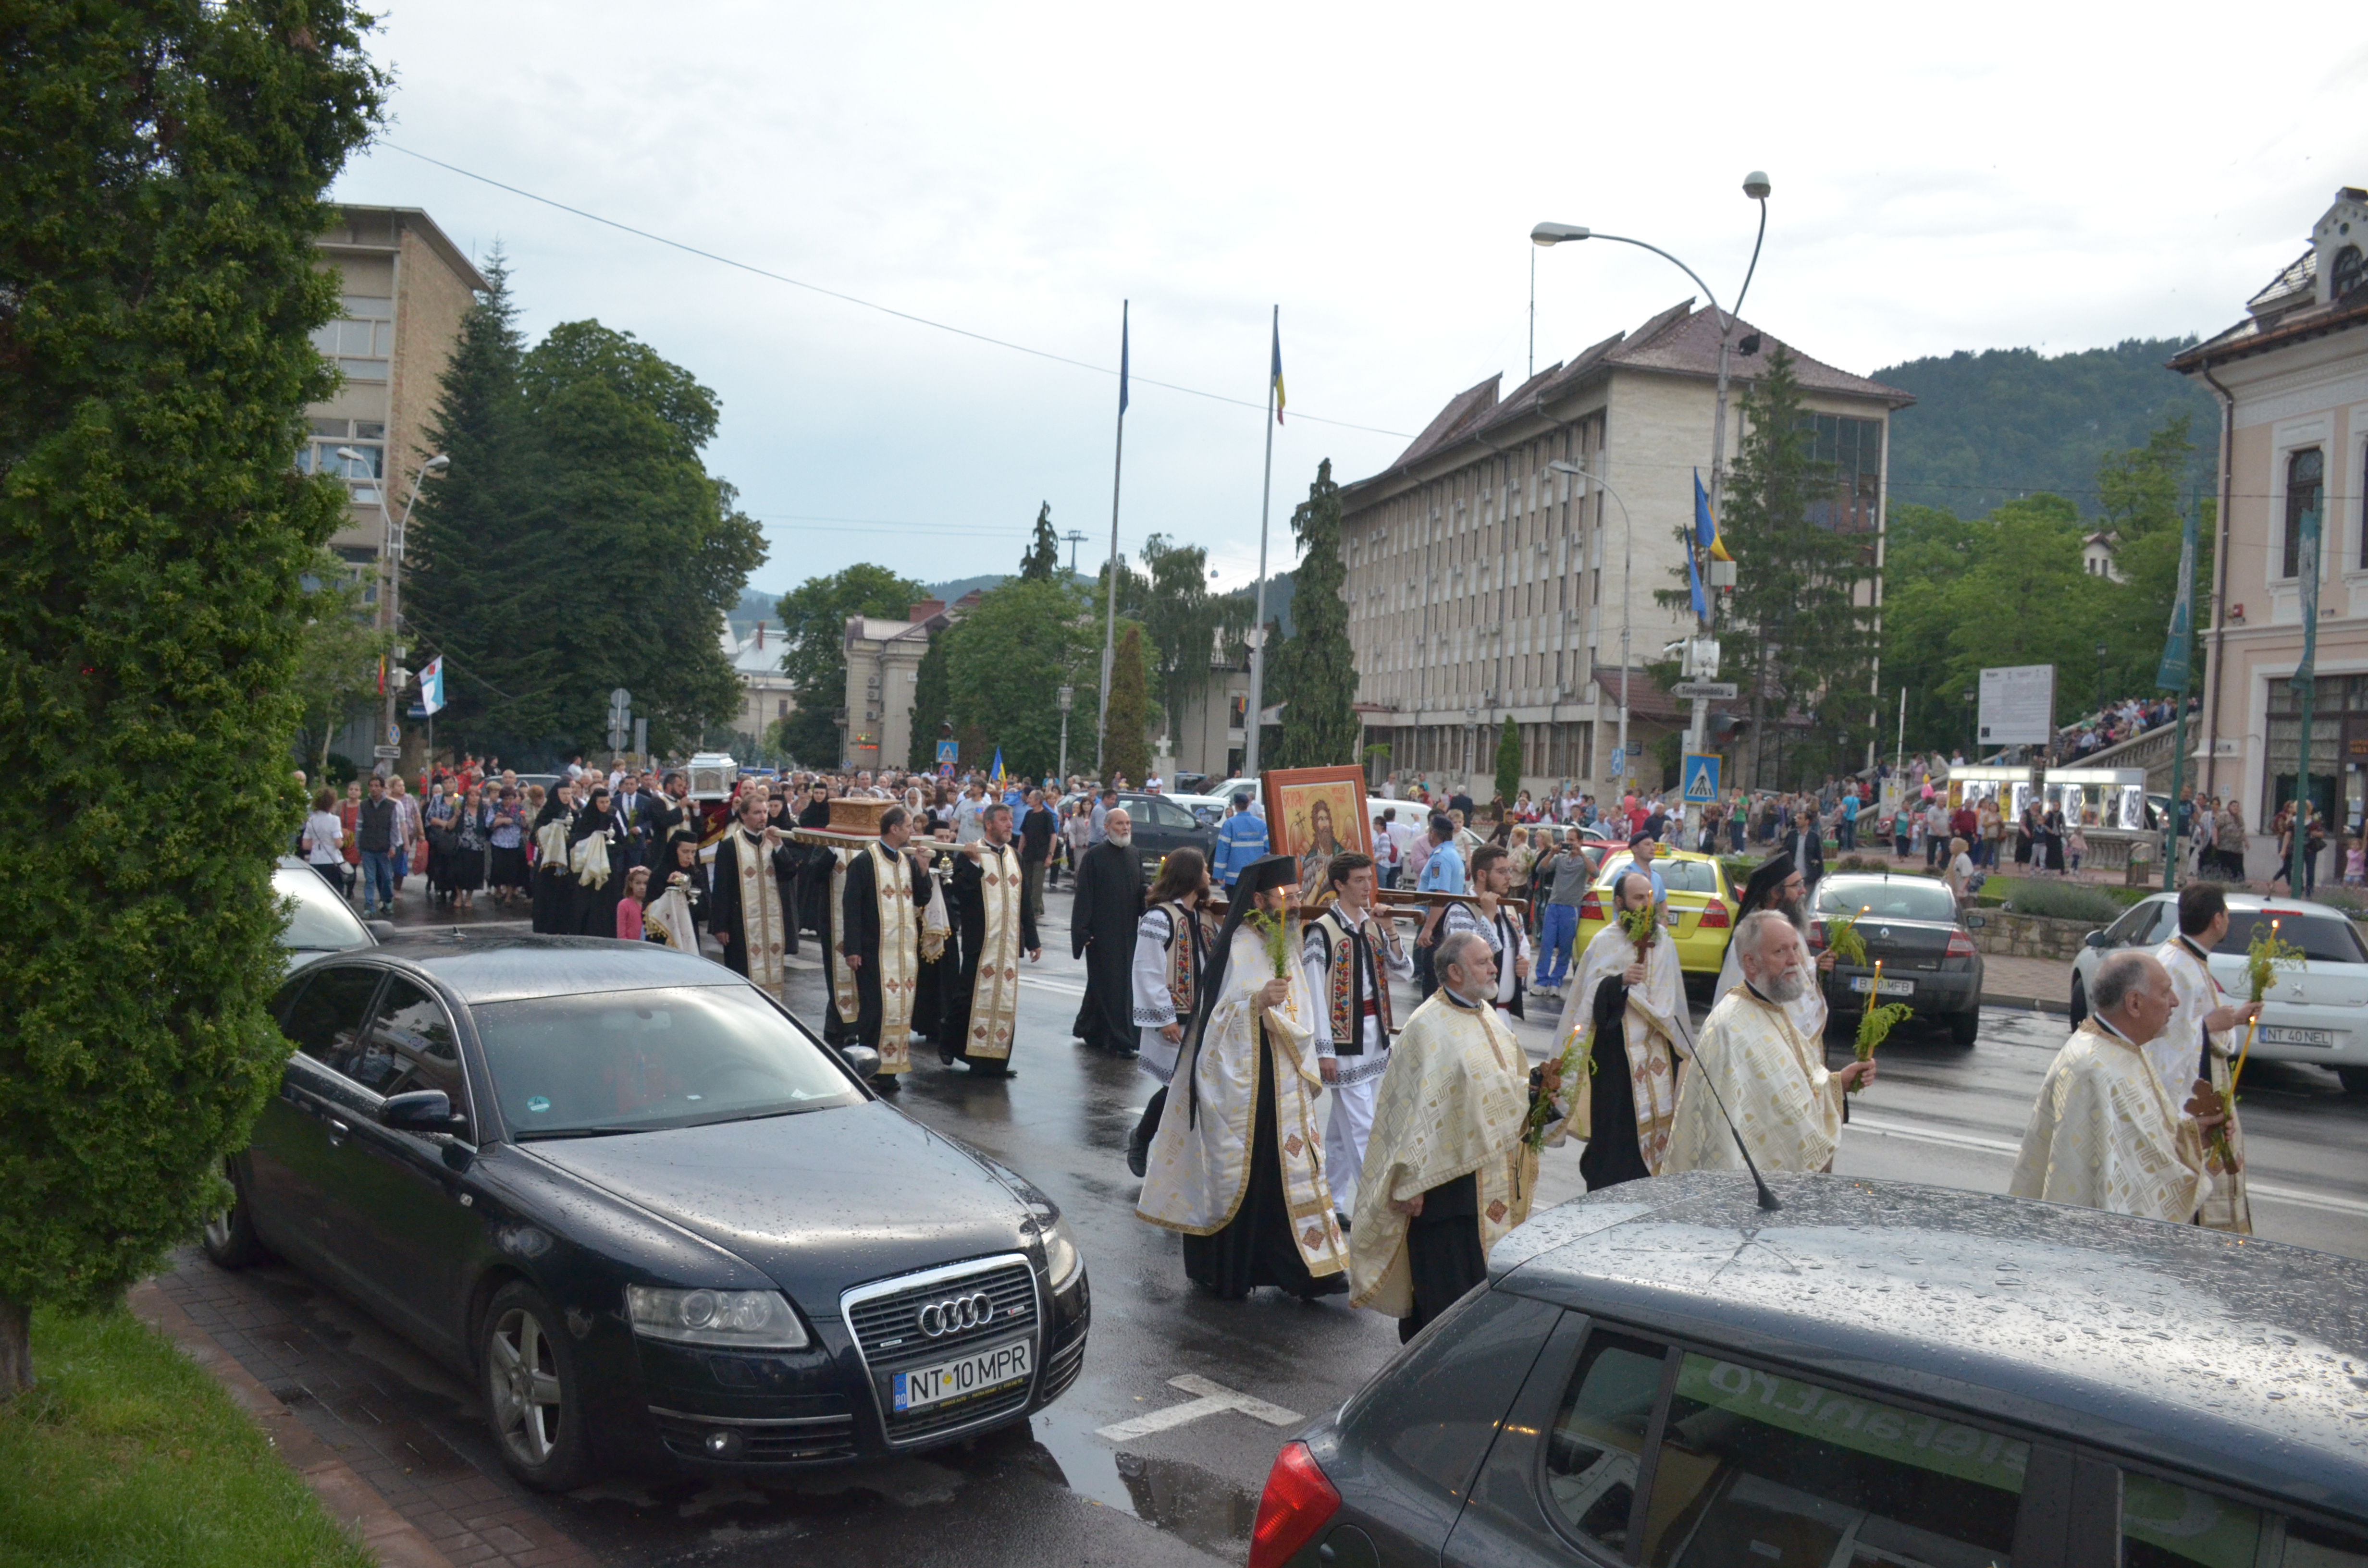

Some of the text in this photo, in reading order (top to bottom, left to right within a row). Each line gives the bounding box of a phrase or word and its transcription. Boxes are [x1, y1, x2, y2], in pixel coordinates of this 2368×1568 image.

[1682, 686, 1724, 697] Telegondola
[1860, 978, 1867, 988] B
[1887, 980, 1909, 992] MFB
[2268, 1029, 2329, 1044] NT 40 NEL
[911, 1345, 1025, 1402] NT 10 MPR
[895, 1393, 906, 1406] RO
